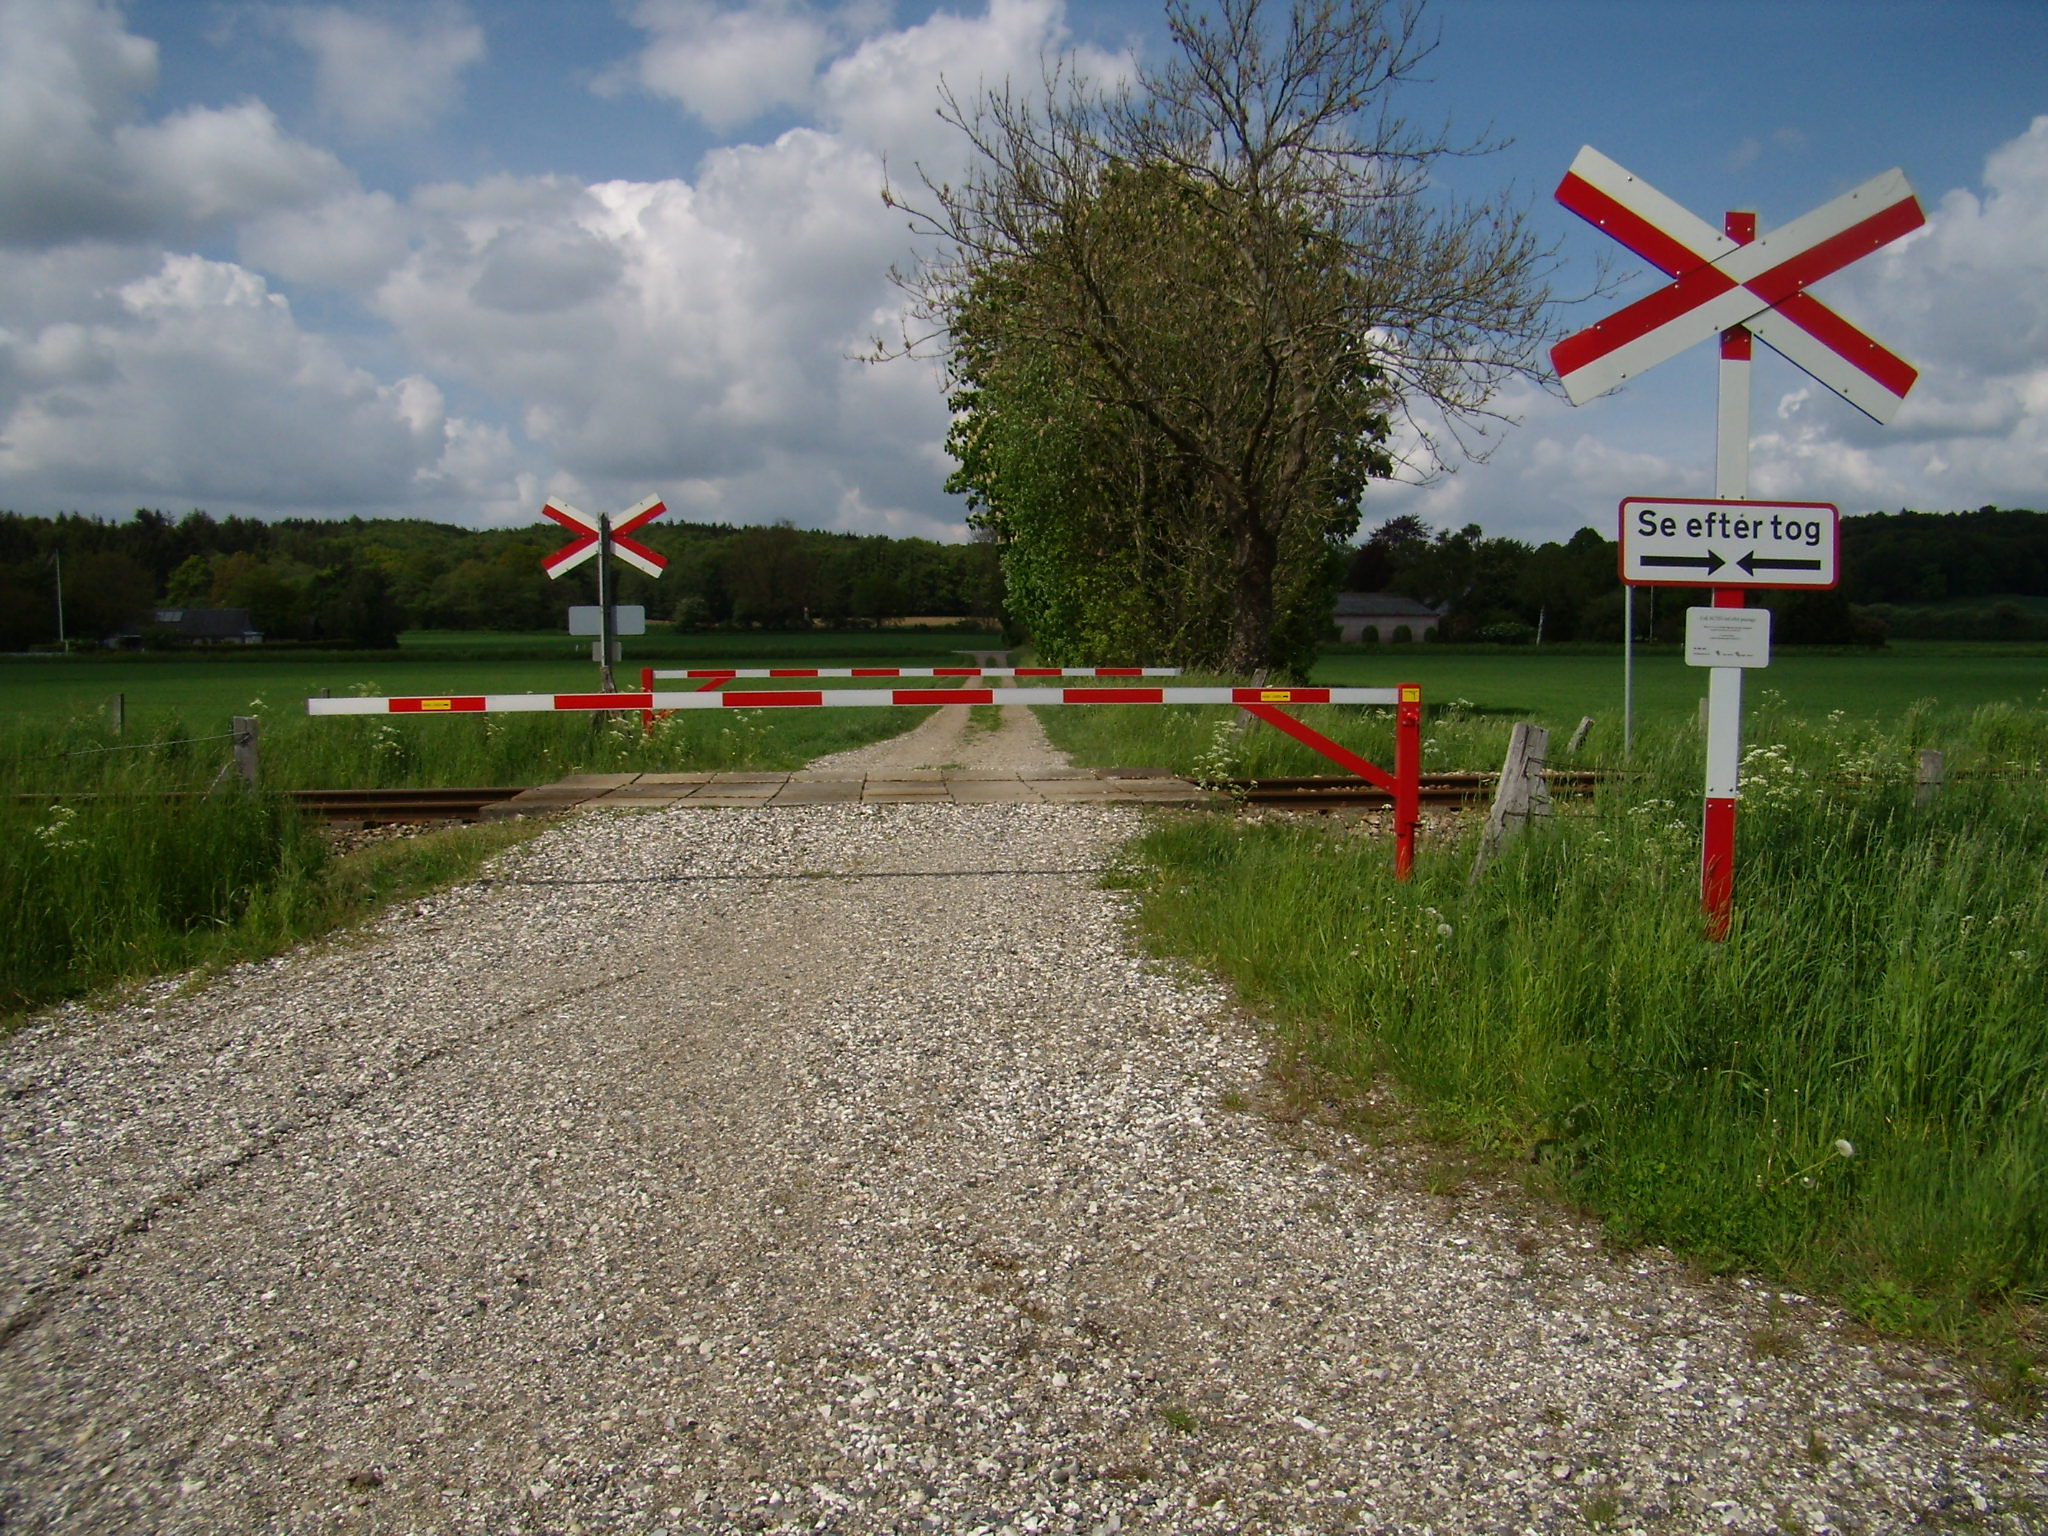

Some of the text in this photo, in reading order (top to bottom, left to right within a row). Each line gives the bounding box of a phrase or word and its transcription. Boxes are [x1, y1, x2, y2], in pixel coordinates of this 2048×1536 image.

[1638, 510, 1820, 546] Se efter tog
